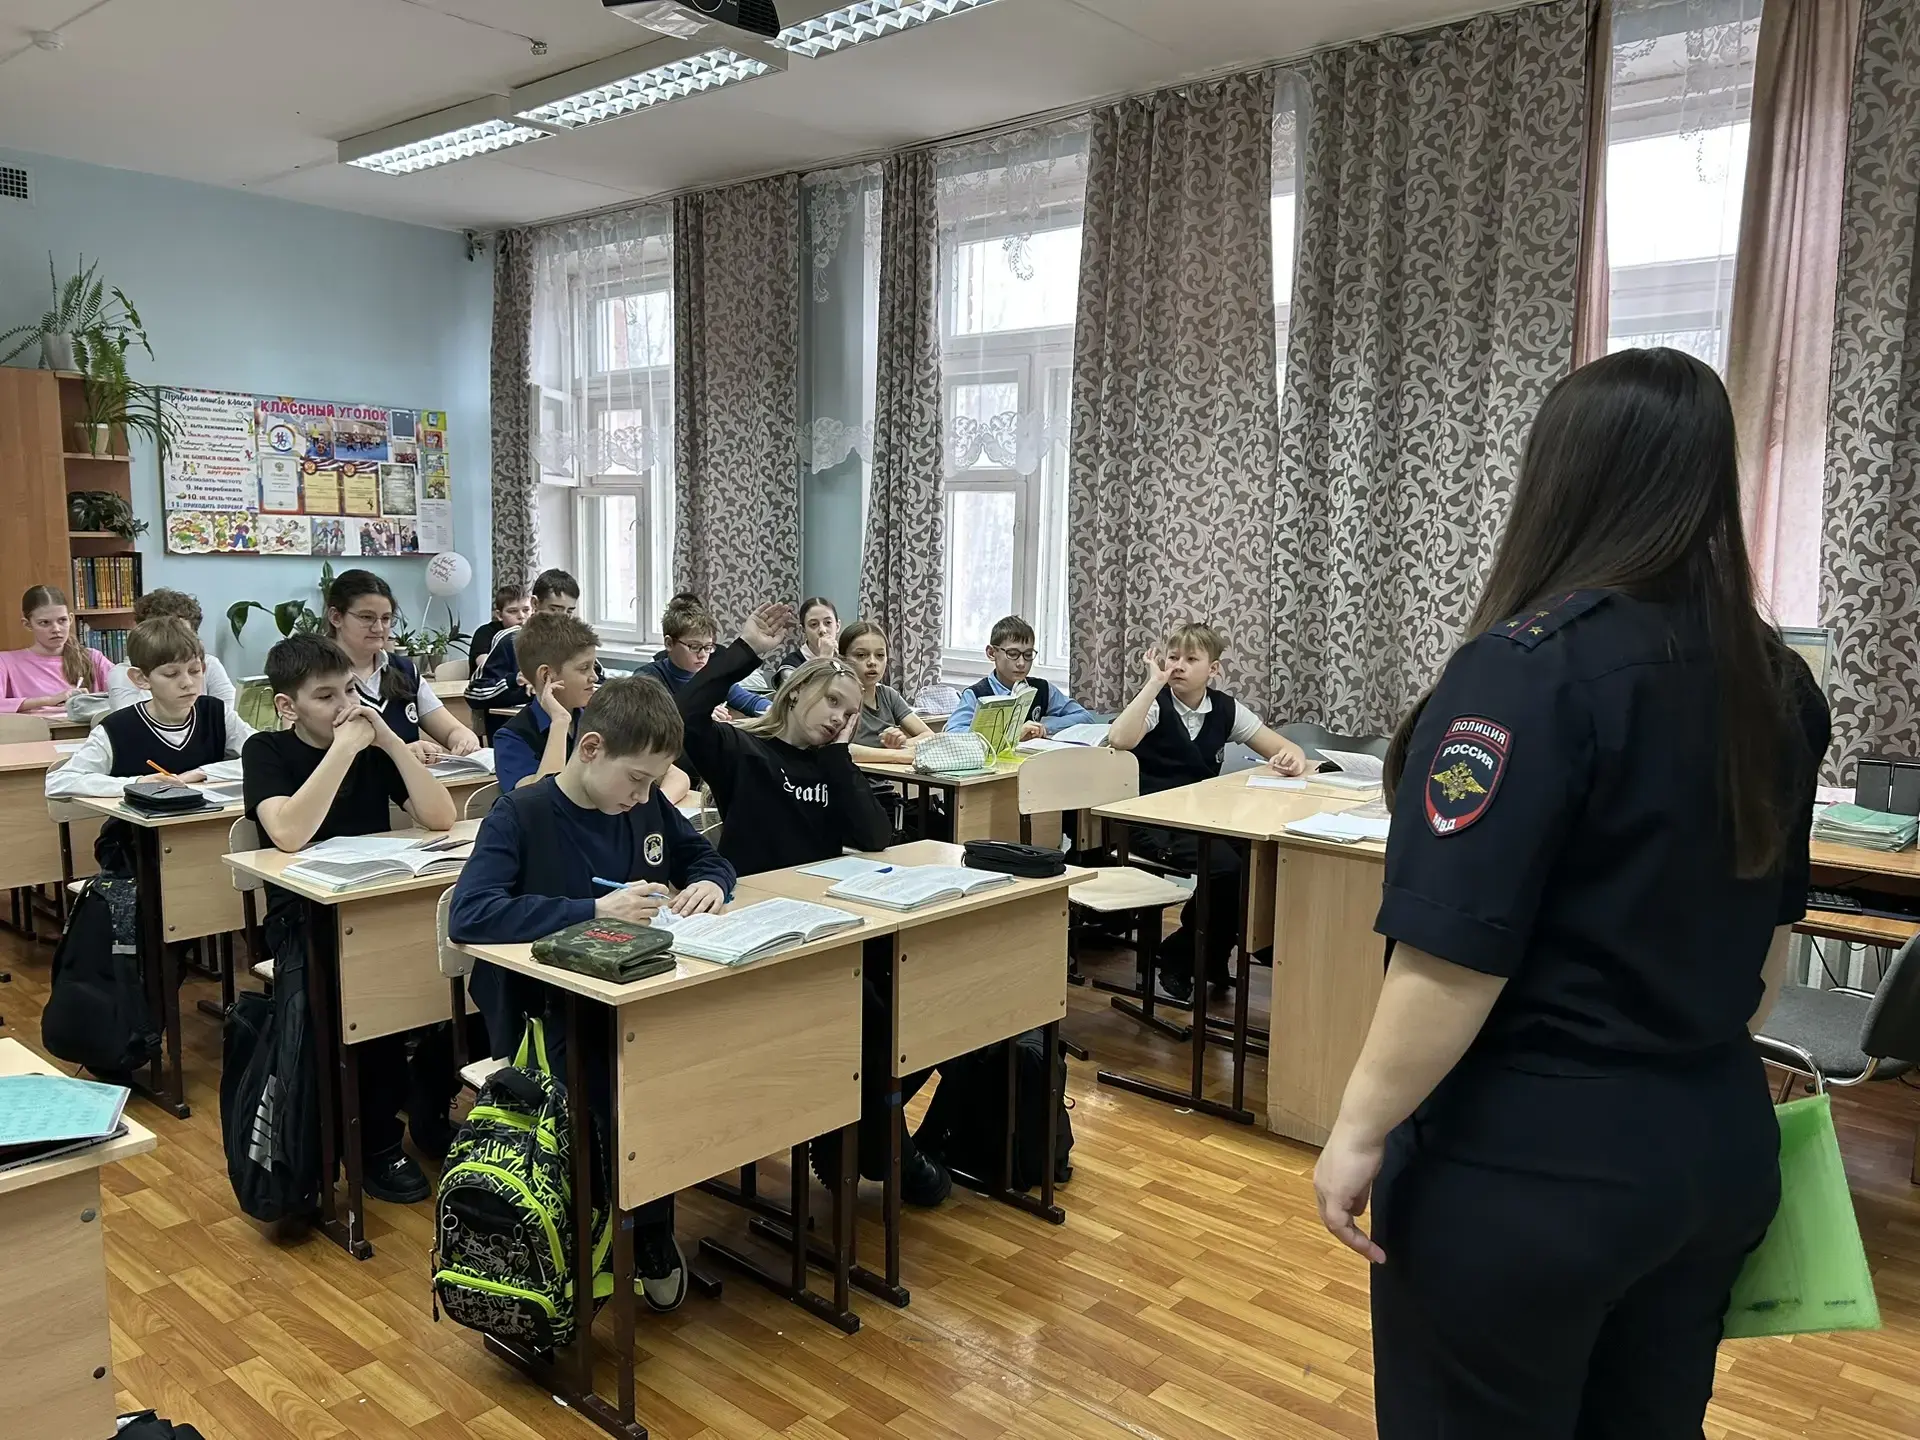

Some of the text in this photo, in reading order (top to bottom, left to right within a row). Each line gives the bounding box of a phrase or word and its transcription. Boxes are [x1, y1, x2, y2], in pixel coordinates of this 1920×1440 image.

[260, 400, 335, 418] КЛАССНЫЙ
[338, 407, 388, 422] УГОЛОК
[1451, 721, 1507, 745] ПОЛИЦИЯ
[1442, 744, 1494, 770] РОССИЯ
[1432, 812, 1457, 832] МВД
